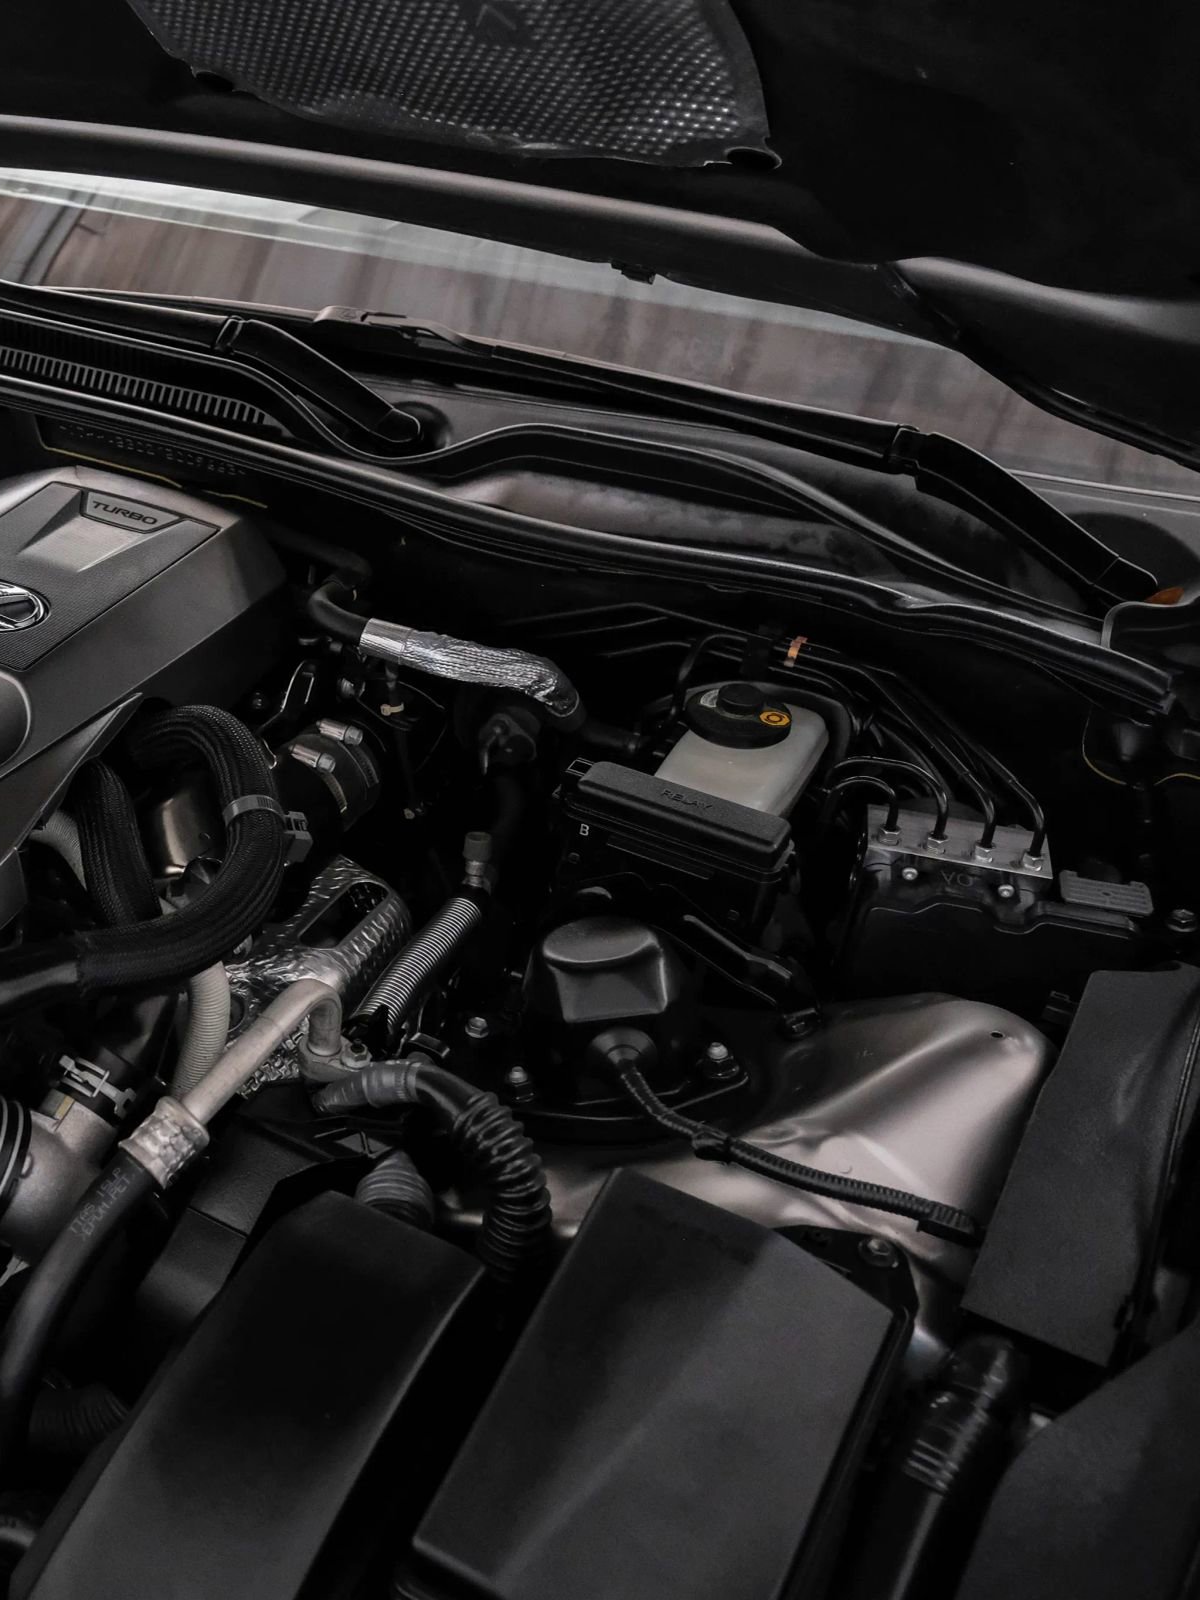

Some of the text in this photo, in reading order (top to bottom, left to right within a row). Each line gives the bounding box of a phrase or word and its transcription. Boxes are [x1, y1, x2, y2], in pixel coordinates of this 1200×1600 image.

[92, 500, 158, 526] TURBO
[660, 789, 713, 810] RELAY
[579, 823, 590, 837] B
